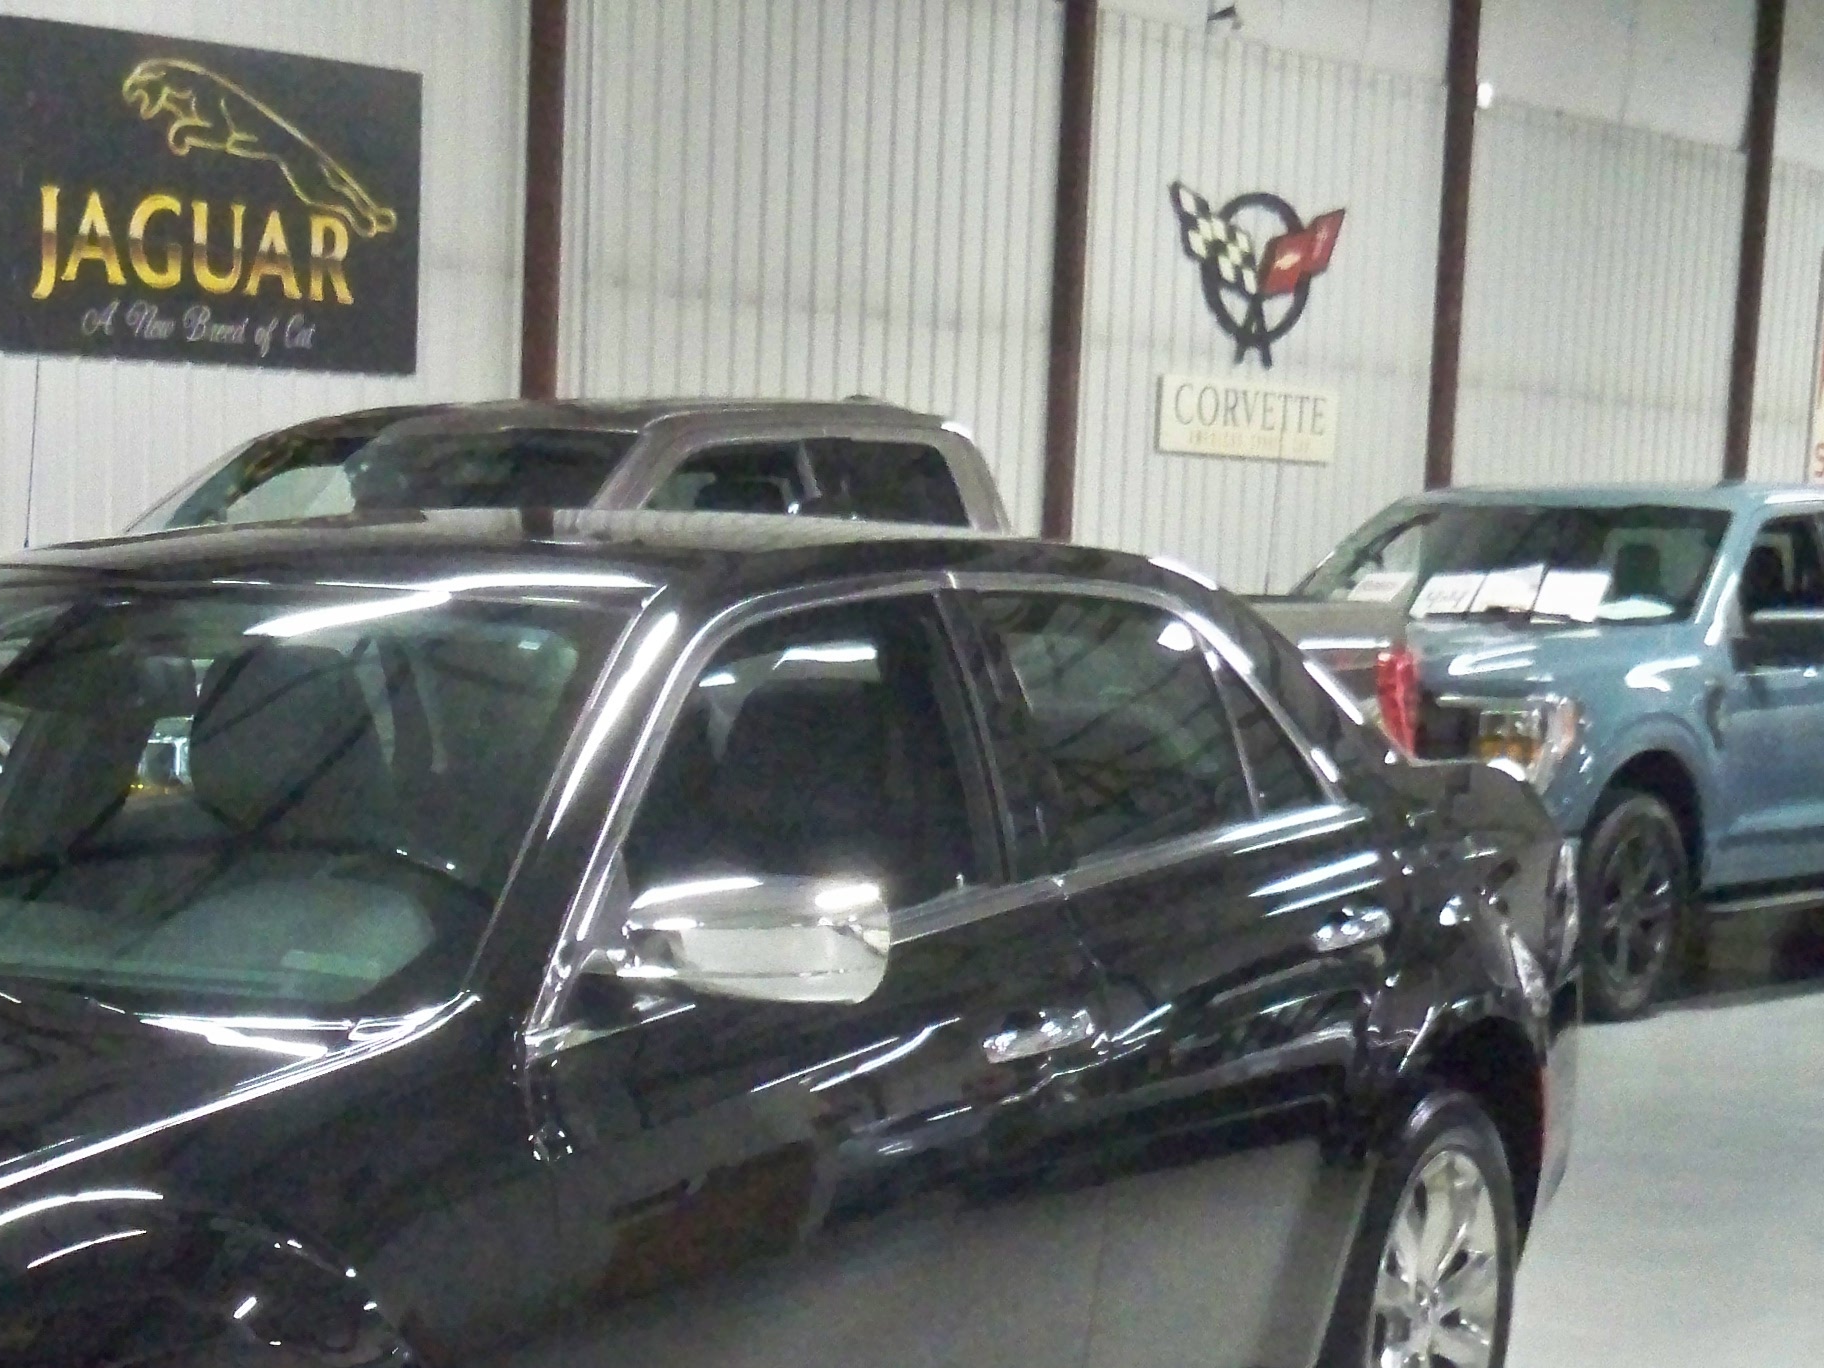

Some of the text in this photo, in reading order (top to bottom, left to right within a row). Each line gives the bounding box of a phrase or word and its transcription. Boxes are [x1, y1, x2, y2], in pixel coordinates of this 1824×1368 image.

[31, 185, 354, 304] JAGUAR
[255, 318, 279, 358] of
[1174, 383, 1328, 436] CORVETTE
